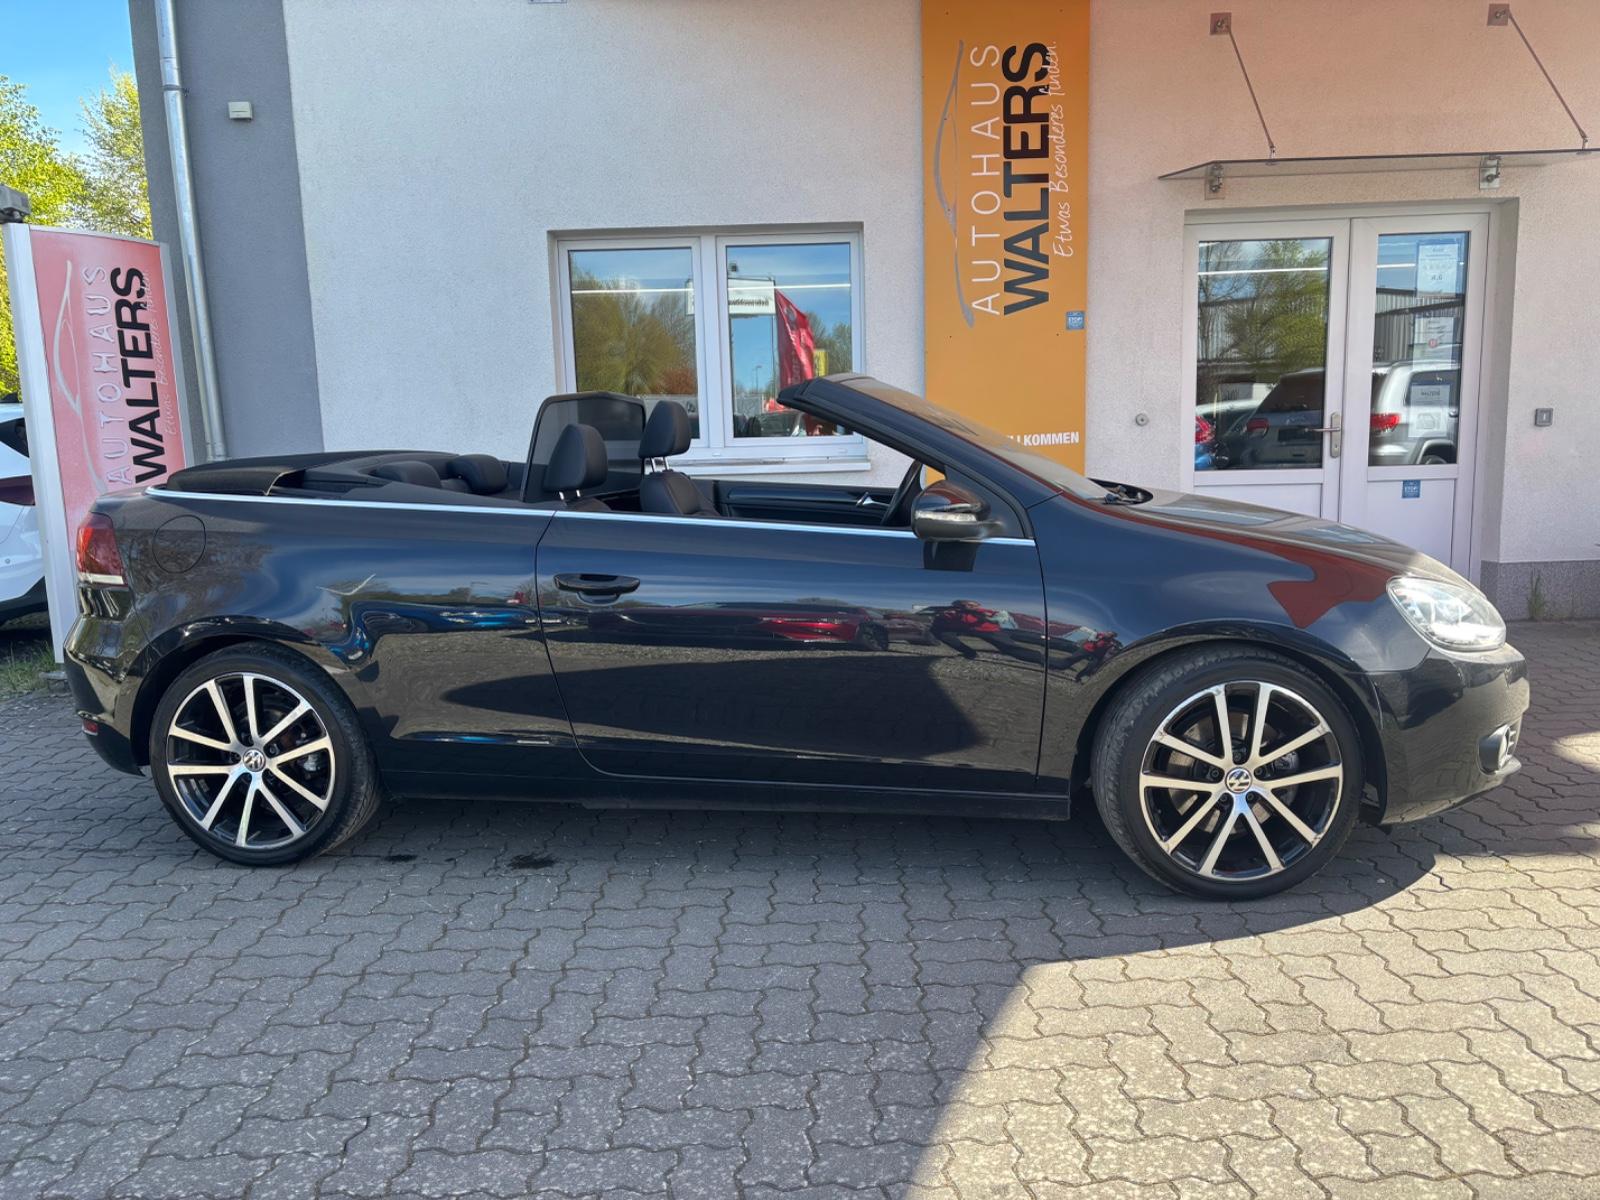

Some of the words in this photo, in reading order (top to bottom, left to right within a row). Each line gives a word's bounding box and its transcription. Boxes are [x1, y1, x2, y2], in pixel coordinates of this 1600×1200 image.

[970, 45, 1001, 315] AUTOHAUS
[1002, 42, 1050, 316] WALTERS
[1048, 103, 1069, 193] Besonderes
[1052, 201, 1074, 257] Etwas
[82, 265, 133, 485] AUTOHAUS
[110, 266, 168, 484] WALTERS
